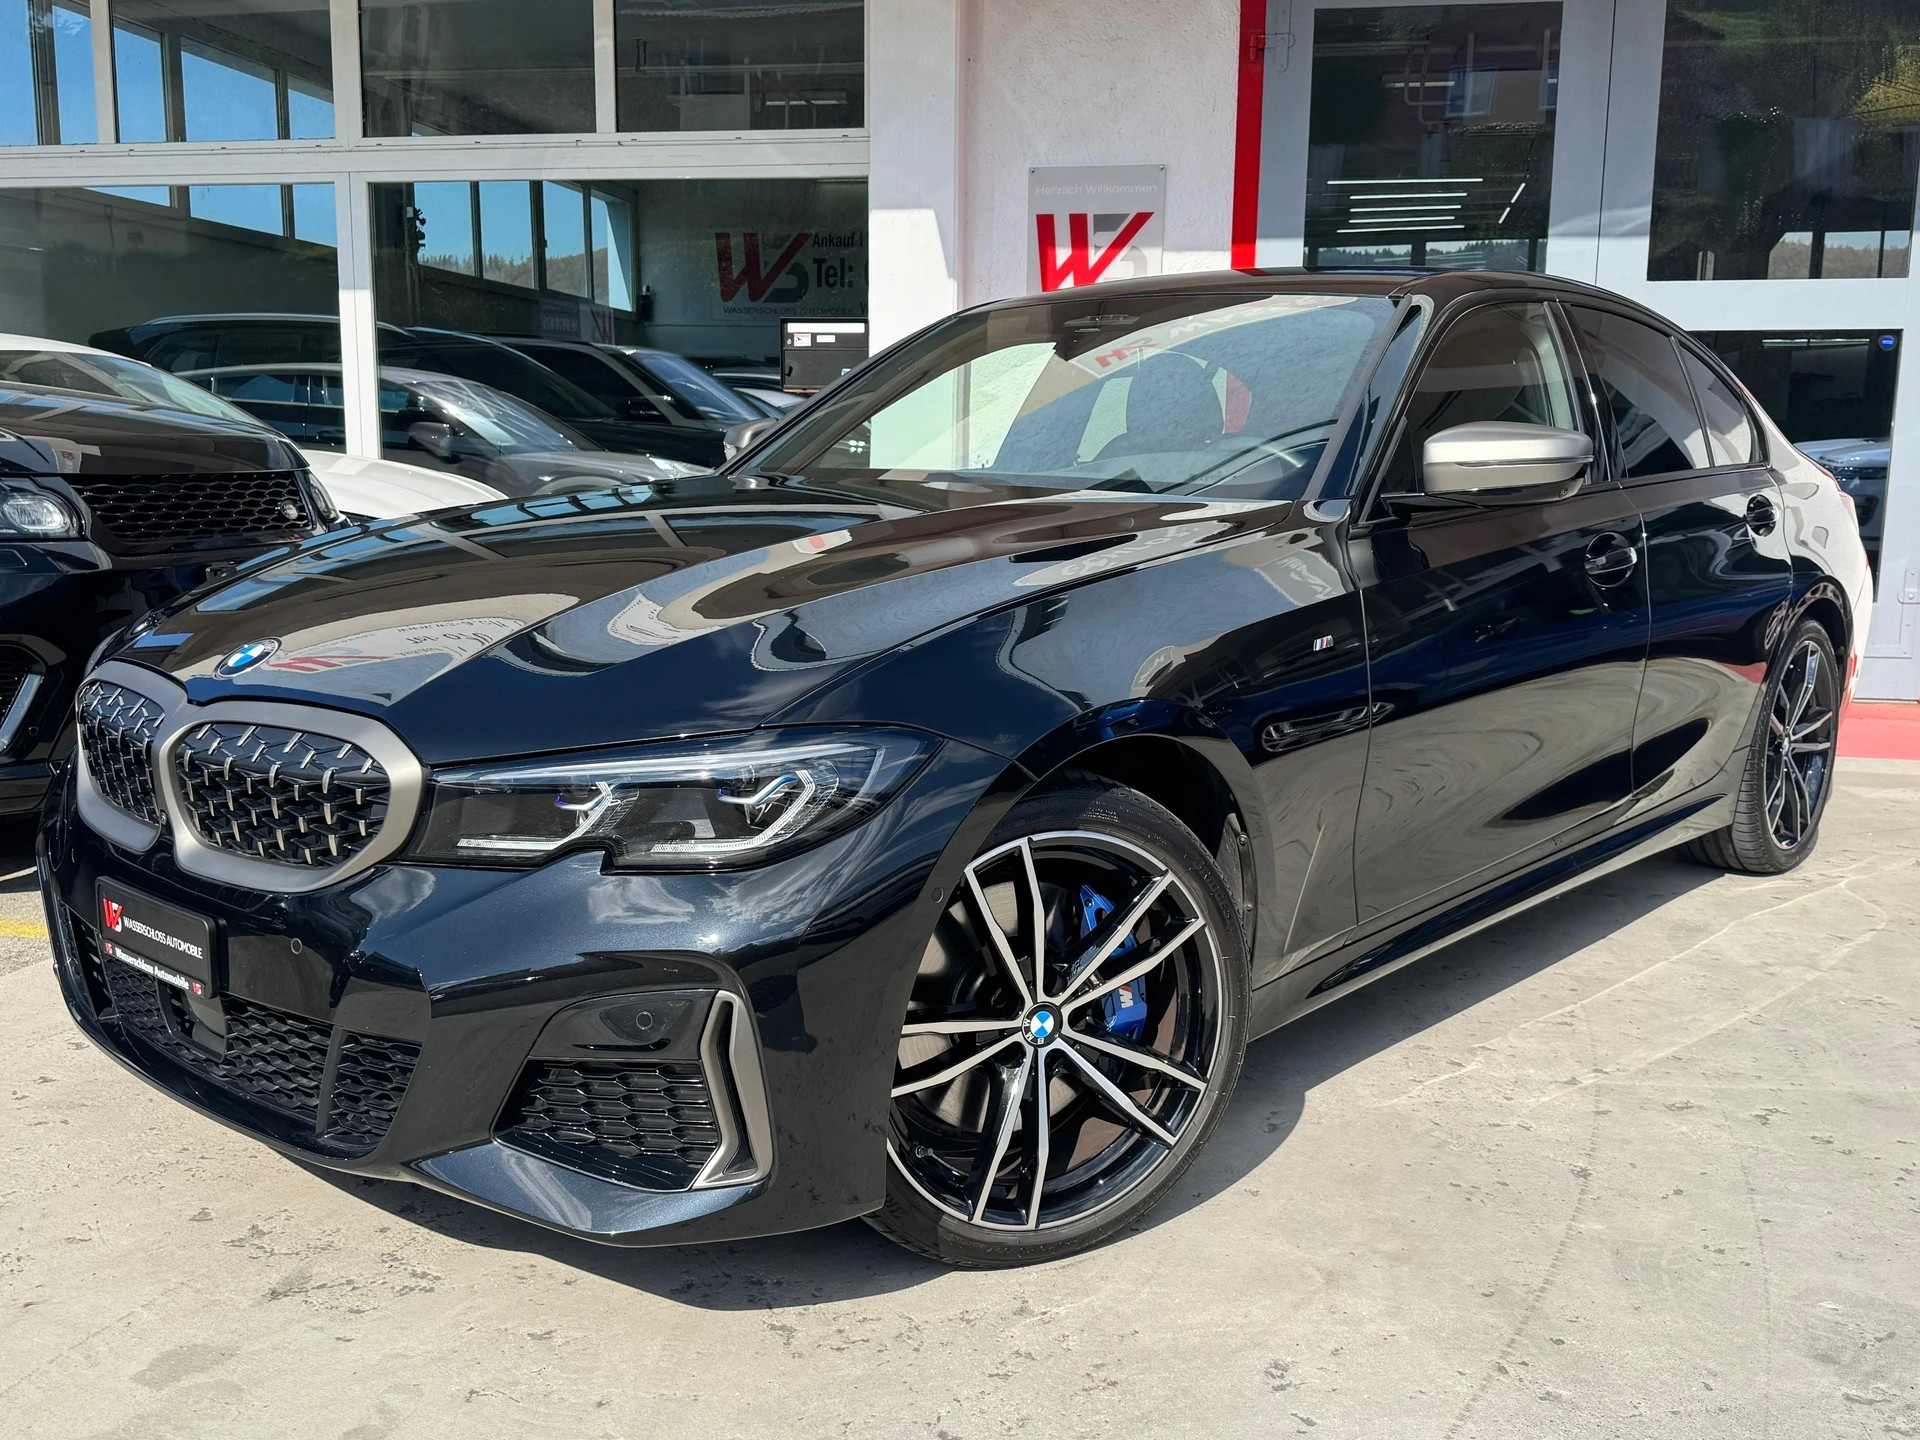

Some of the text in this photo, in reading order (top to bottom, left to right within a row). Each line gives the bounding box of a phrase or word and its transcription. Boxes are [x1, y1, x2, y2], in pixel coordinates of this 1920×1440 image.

[1035, 184, 1157, 195] Herzlich Willkommen
[812, 231, 855, 247] Ankauf
[812, 257, 854, 288] Tel:
[723, 306, 798, 315] WASSERSCHLOSS
[799, 307, 853, 315] AUTOMOBILE
[123, 916, 203, 959] WASSERSCHLOSS AUTOMOBILE
[115, 947, 154, 975] Wasserschloss
[154, 966, 189, 990] Automobile
